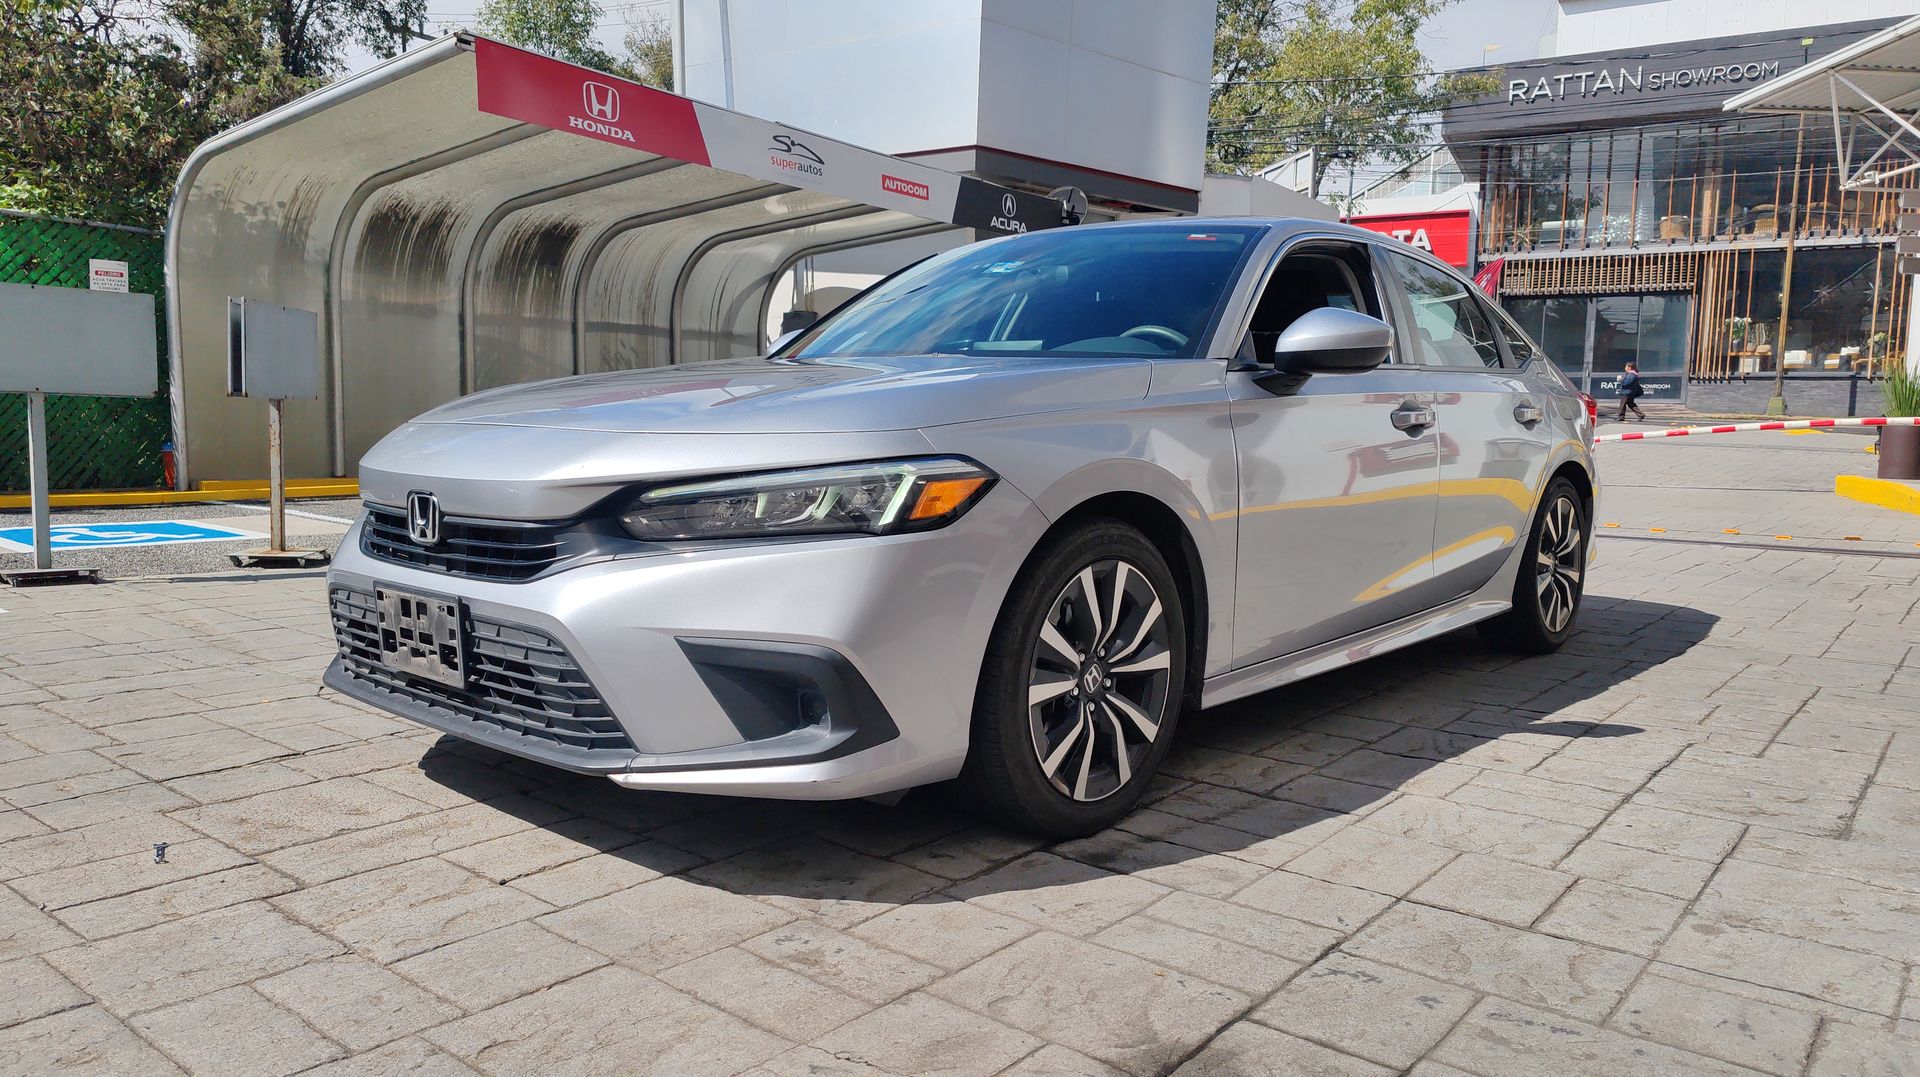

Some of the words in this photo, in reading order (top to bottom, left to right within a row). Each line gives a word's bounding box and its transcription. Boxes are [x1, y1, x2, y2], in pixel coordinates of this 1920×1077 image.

[1508, 65, 1643, 105] RATTAN
[1648, 60, 1780, 91] SHOWROOM
[568, 115, 636, 142] HONDA
[770, 155, 823, 177] superautos
[884, 177, 928, 198] AUTOCOM
[989, 215, 1028, 233] ACURA
